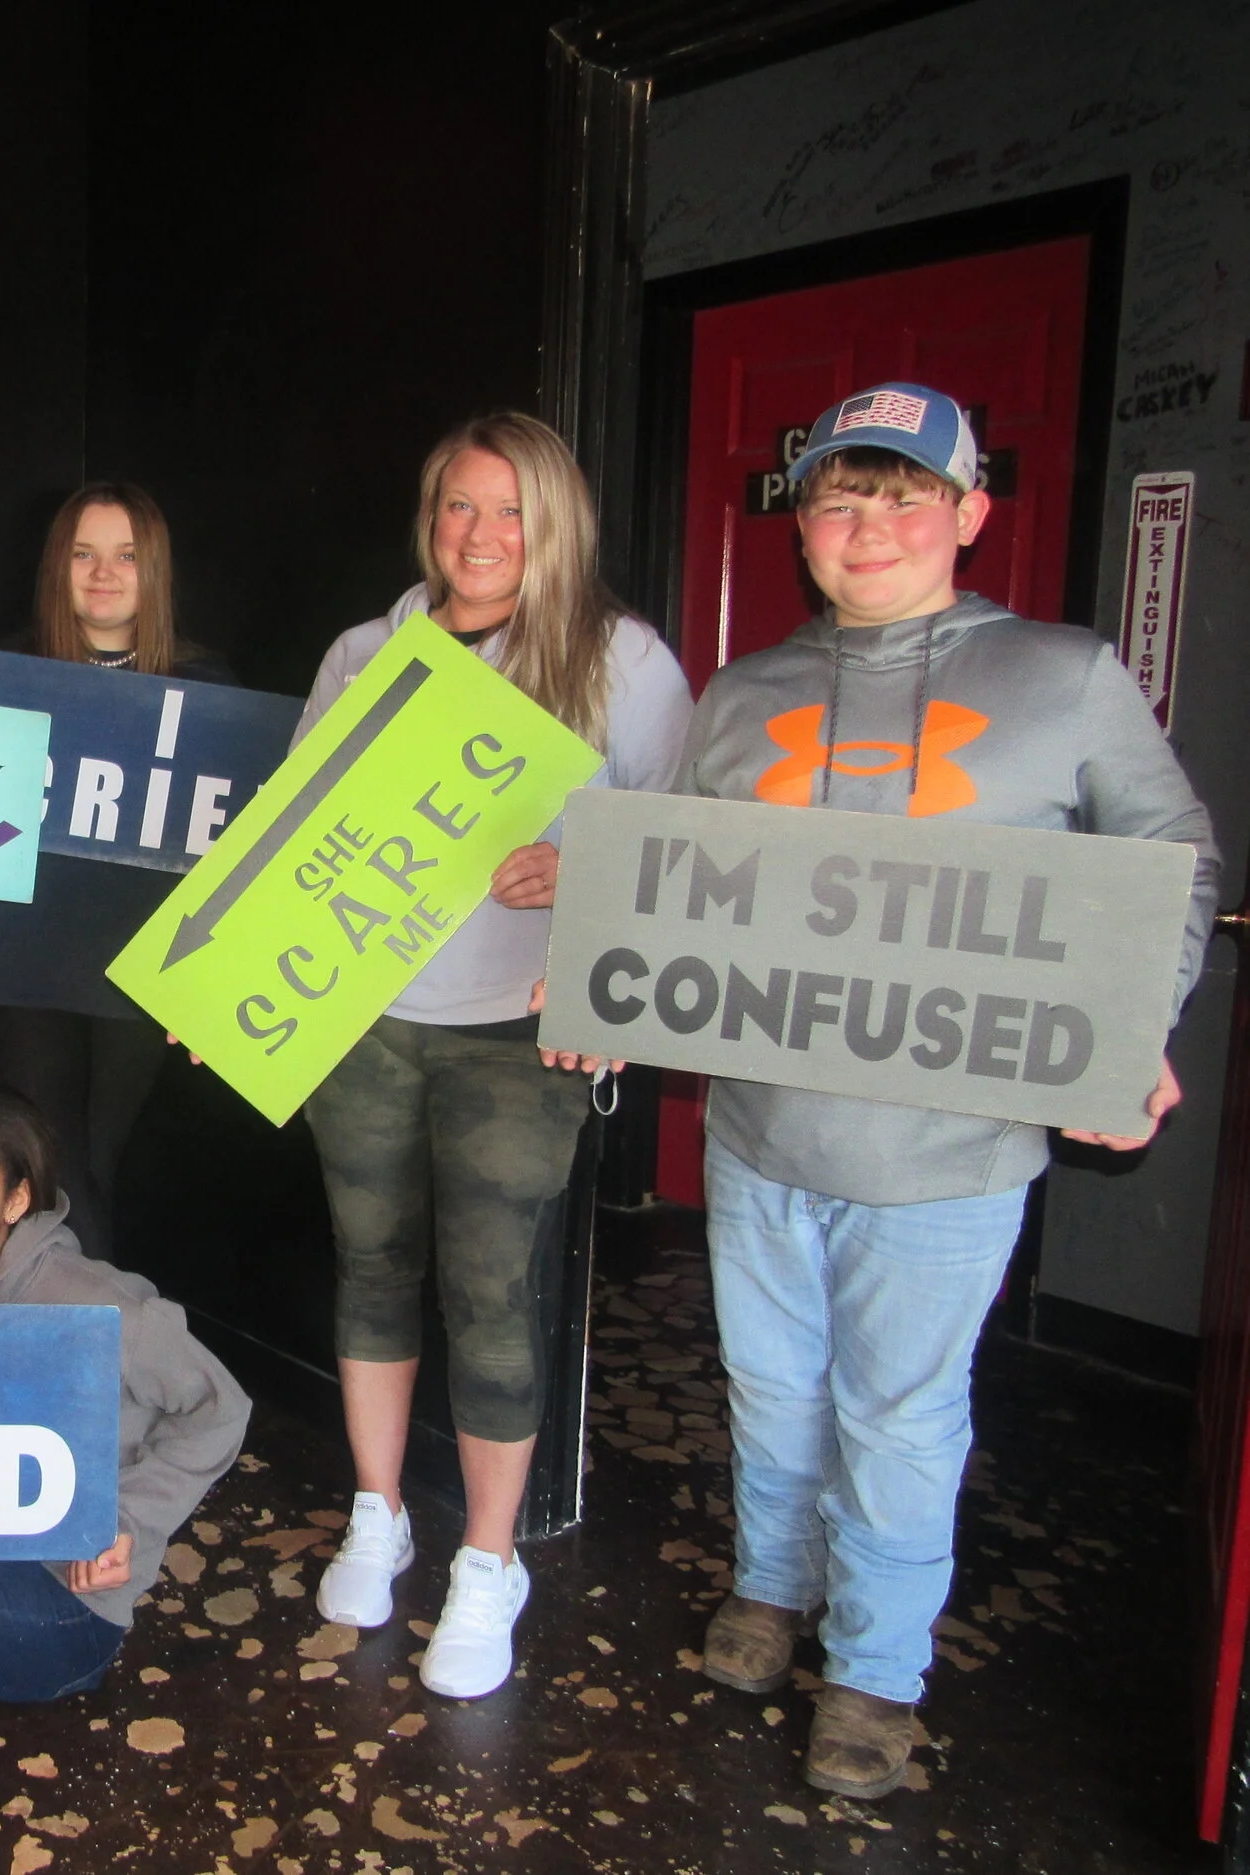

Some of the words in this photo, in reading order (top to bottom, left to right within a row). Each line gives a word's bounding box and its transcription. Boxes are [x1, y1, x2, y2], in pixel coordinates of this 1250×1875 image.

[1138, 498, 1183, 523] FIRE
[1138, 527, 1166, 698] EXTINGUISHE
[154, 689, 185, 759] I
[40, 755, 264, 856] RIE
[235, 733, 527, 1057] SCARES
[294, 813, 375, 902] SHE
[634, 836, 761, 926] I'M
[804, 855, 1067, 963] STILL
[382, 893, 454, 965] ME
[588, 947, 1094, 1087] CONFUSED
